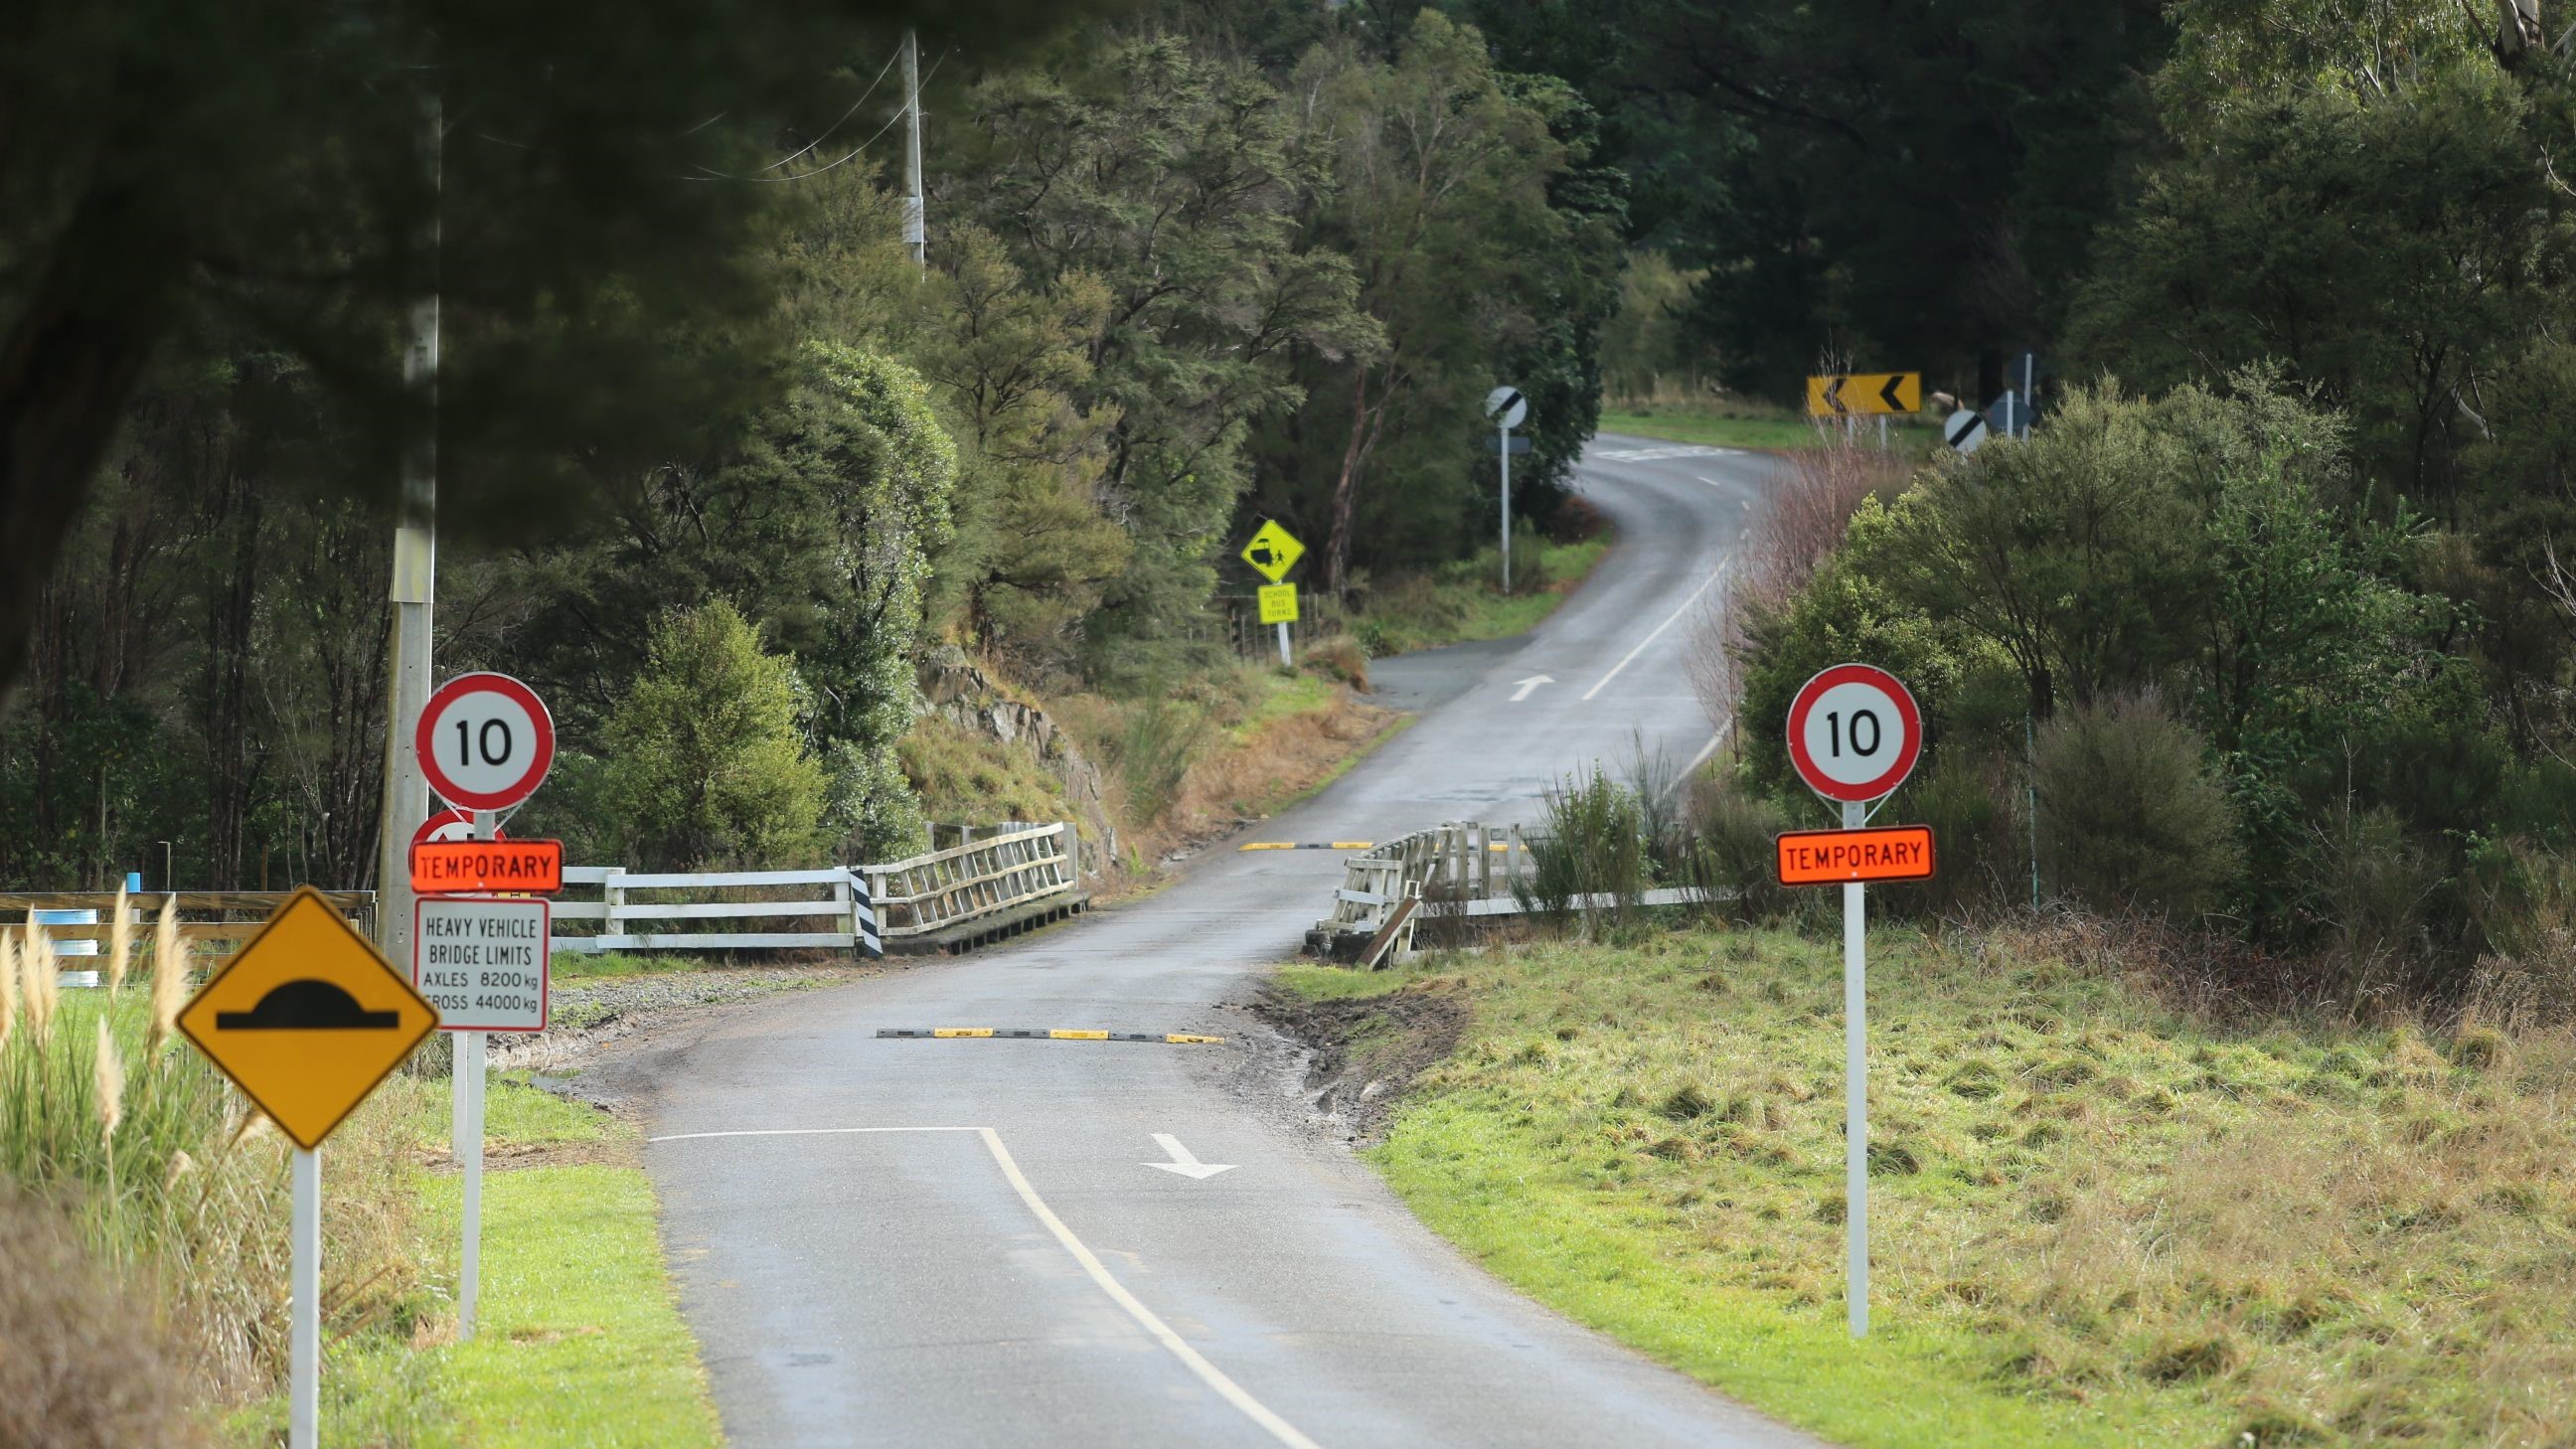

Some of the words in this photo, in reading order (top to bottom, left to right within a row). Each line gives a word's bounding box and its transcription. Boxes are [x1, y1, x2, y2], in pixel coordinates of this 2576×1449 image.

[1263, 589, 1291, 599] SCHOOL
[1271, 599, 1286, 608] BUS
[1267, 608, 1291, 617] TURNS
[455, 718, 513, 766] 10
[1827, 709, 1881, 757] 10
[420, 854, 554, 880] TEMPORARY
[1787, 841, 1922, 871] TEMPORARY
[425, 917, 473, 938] HEAVY
[479, 918, 538, 939] VEHICLE
[429, 944, 480, 966] BRIDGE
[485, 945, 533, 967] LIMITS
[423, 972, 469, 987] AXLES
[425, 995, 469, 1010] ROSS
